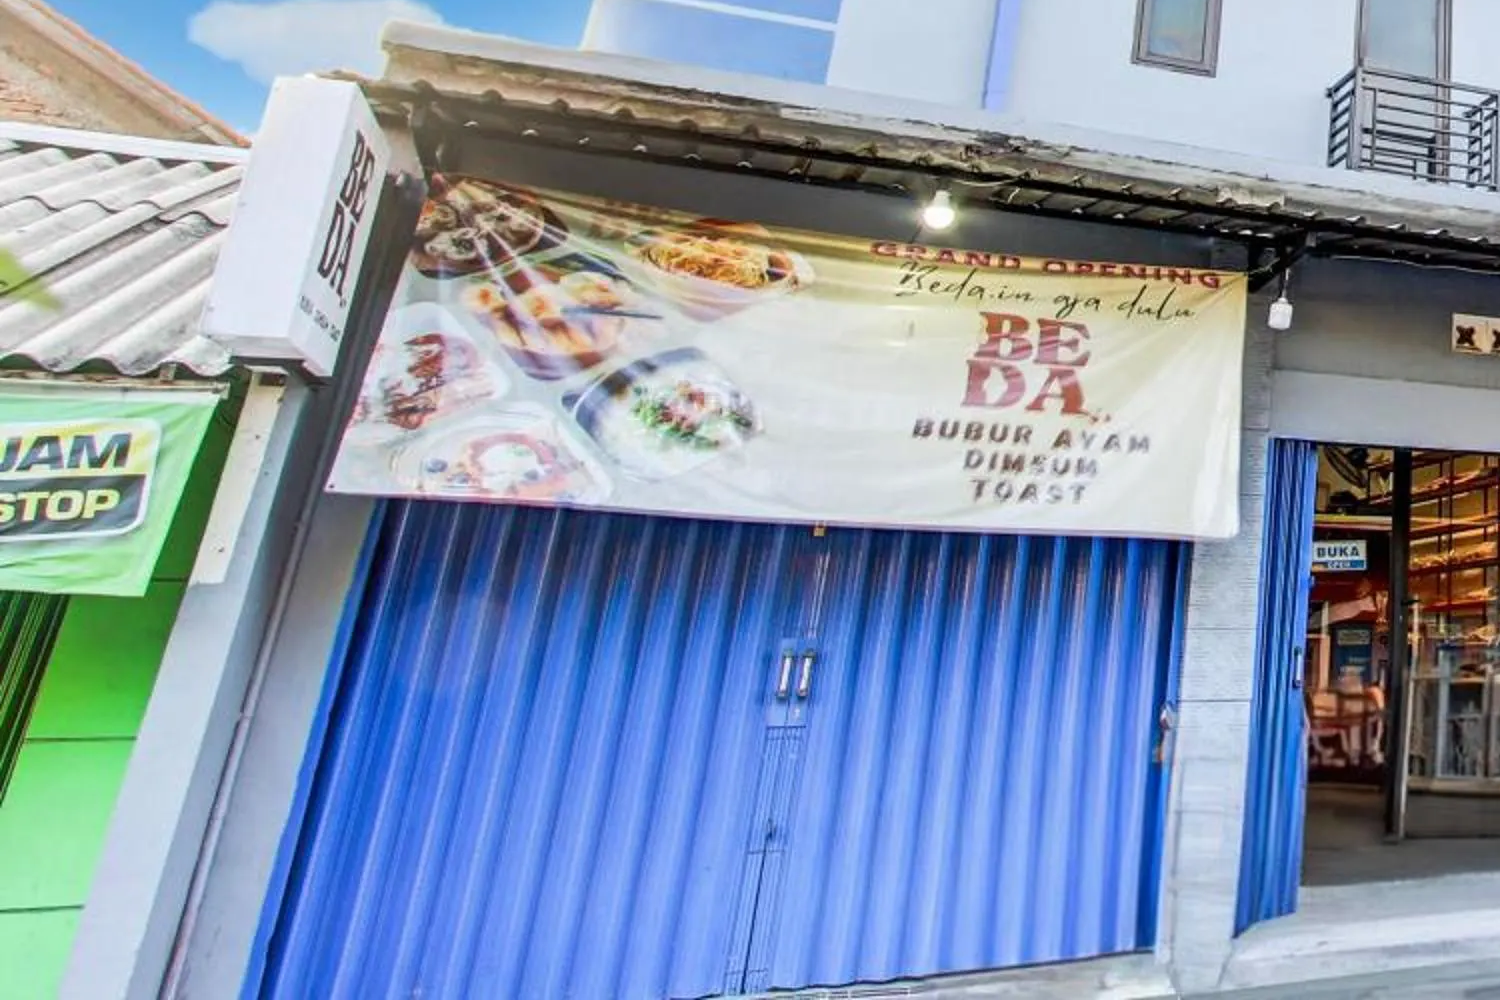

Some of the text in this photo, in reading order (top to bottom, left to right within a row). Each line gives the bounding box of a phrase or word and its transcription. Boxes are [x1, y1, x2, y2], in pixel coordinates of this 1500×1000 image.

[340, 129, 376, 223] BE
[870, 241, 1221, 290] GRAND OPENING
[973, 312, 1091, 367] BE
[912, 418, 1151, 454] BUBUR AYAM
[963, 448, 1099, 478] DIMSUM
[0, 489, 120, 522] STOP
[970, 478, 1087, 505] TOAST
[1316, 545, 1360, 558] BUKA
